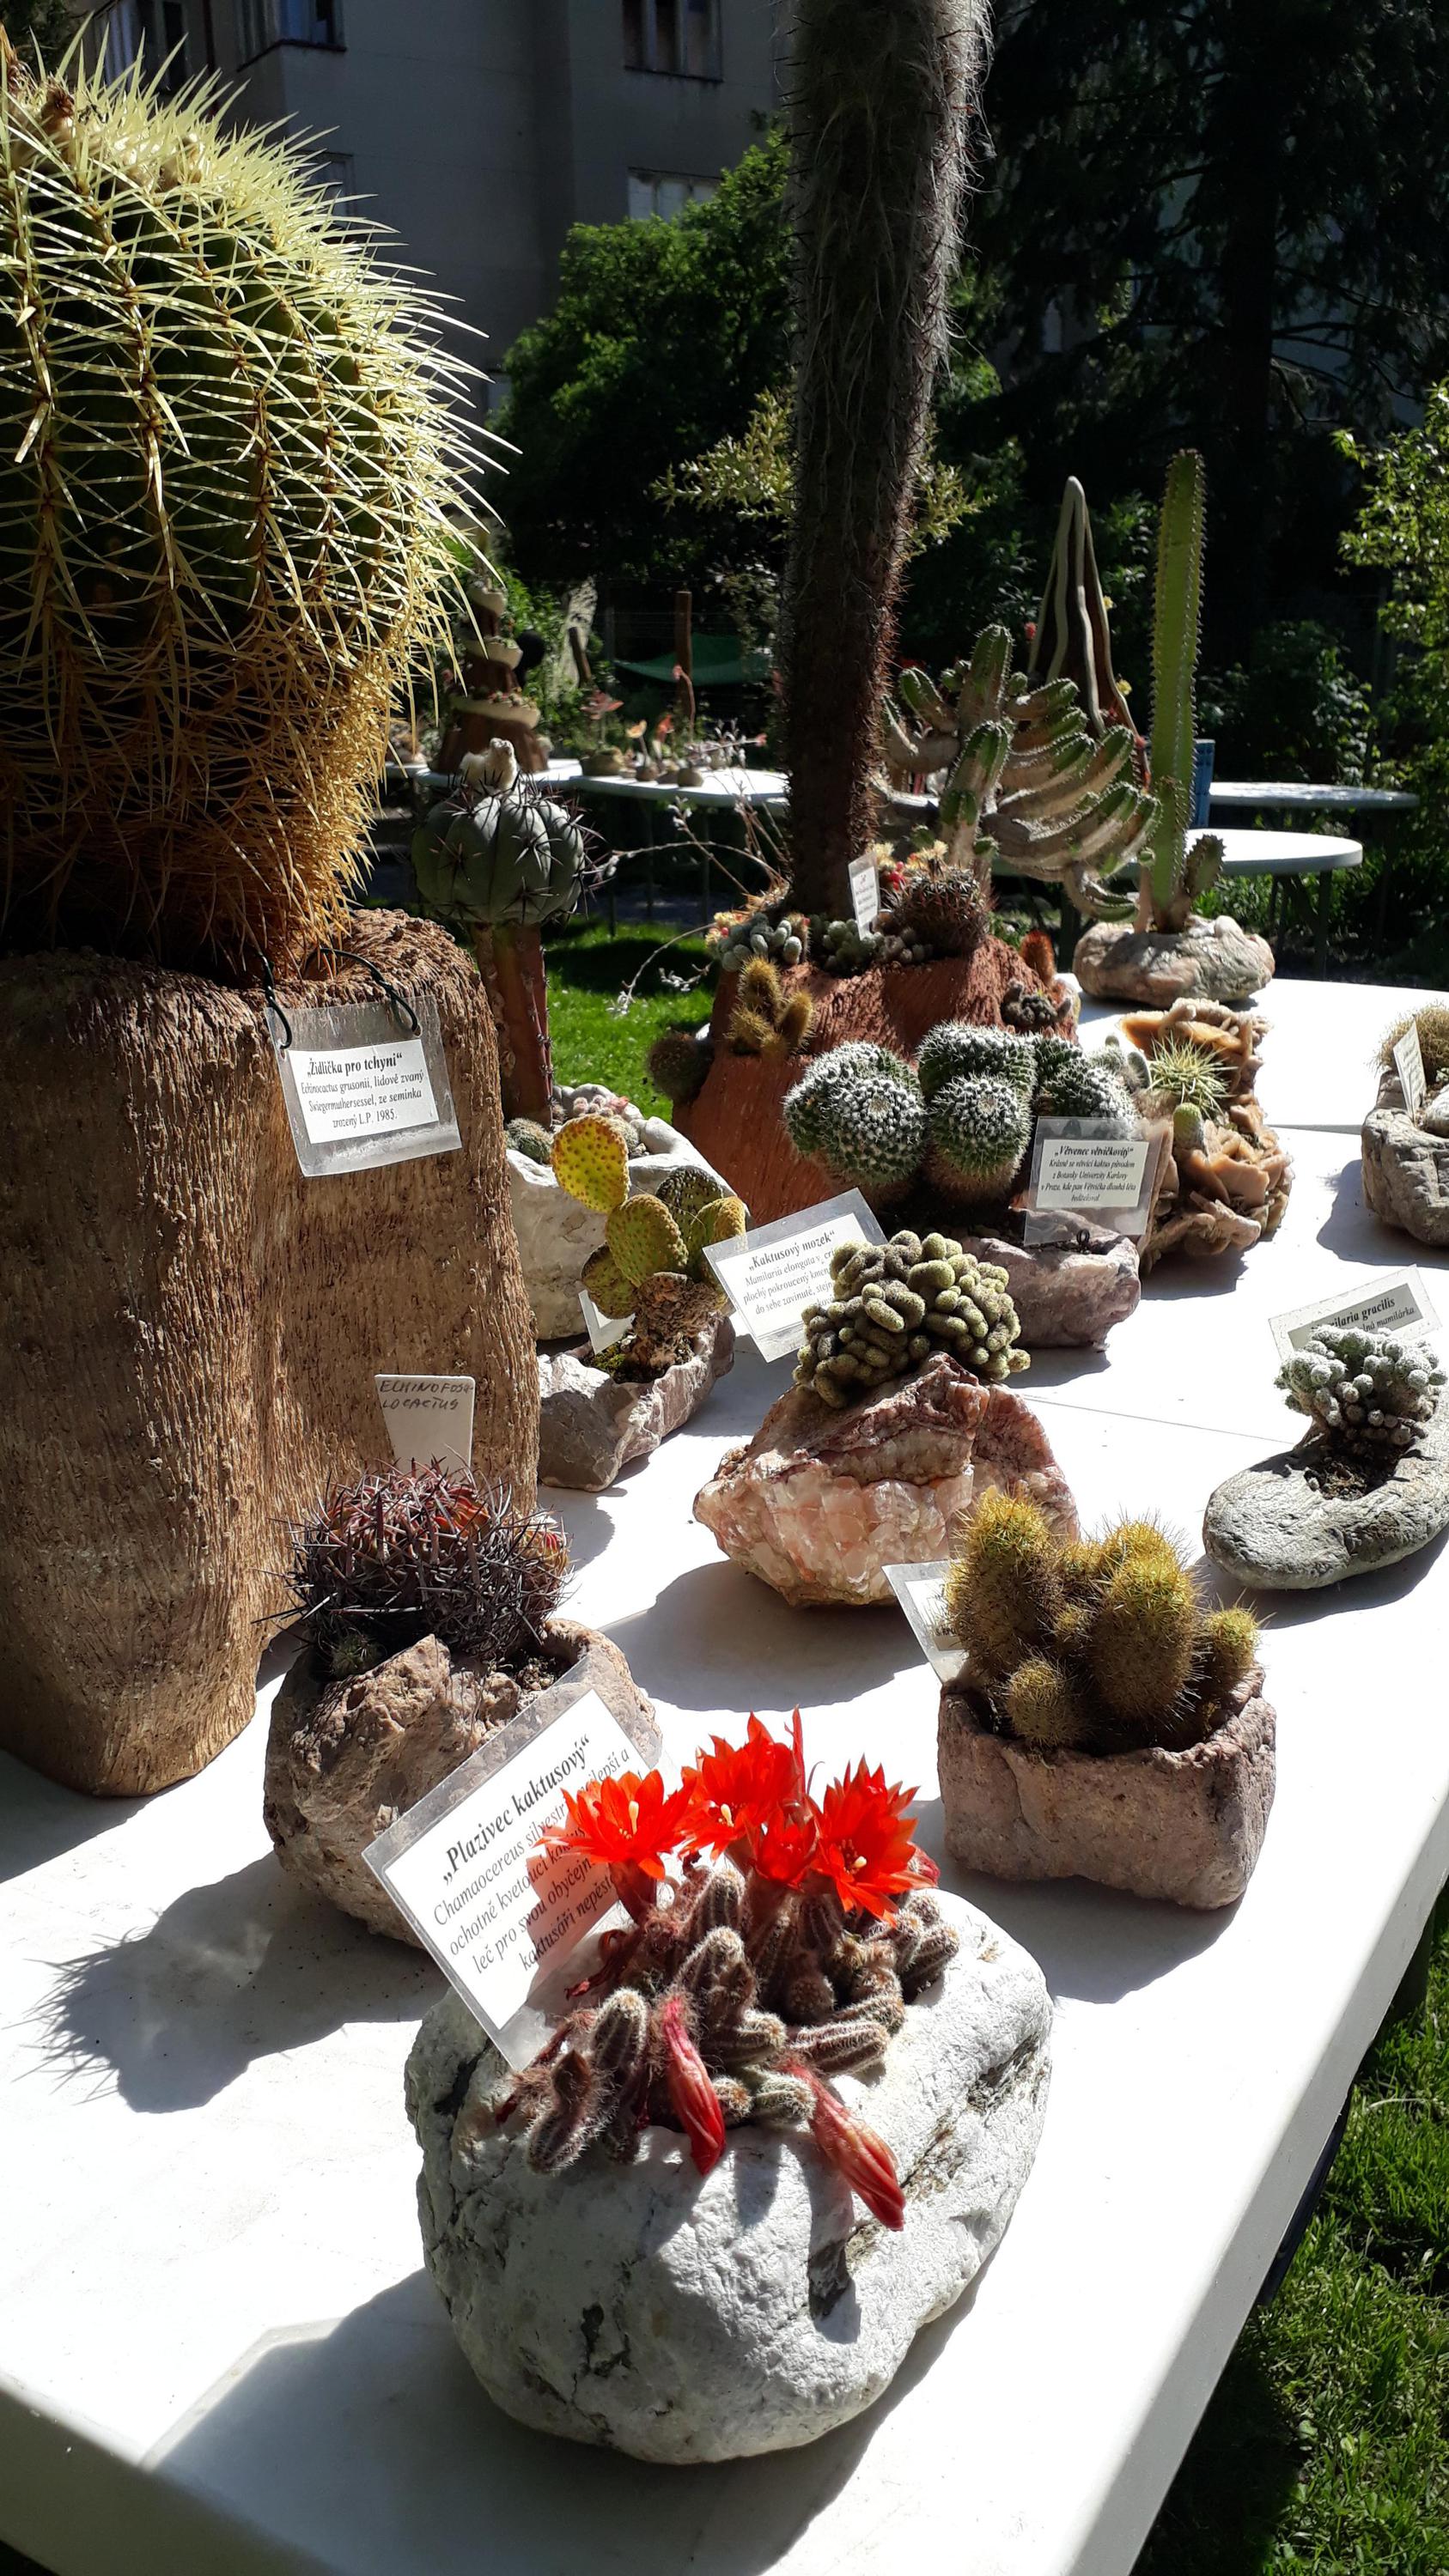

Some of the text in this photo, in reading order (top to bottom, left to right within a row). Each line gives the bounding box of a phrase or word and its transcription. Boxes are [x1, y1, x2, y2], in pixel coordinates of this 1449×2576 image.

[345, 1061, 361, 1076] pro
[364, 1053, 402, 1072] tchyni“
[301, 1069, 424, 1094] Echinocactus grusonii, lidově zvaný
[378, 1094, 387, 1104] ze
[332, 1108, 398, 1128] zrozený L.P. 1985.
[1094, 1159, 1110, 1168] kaktus
[1106, 1171, 1128, 1181] Karlovy
[749, 1230, 835, 1271] „Kaktusový mozek“
[783, 1257, 815, 1273] elongata
[825, 1249, 835, 1260] cri
[744, 1287, 767, 1305] plochý
[768, 1273, 809, 1297] pokroucený
[756, 1304, 764, 1315] do
[767, 1299, 782, 1310] sebe
[816, 1281, 833, 1293] stejn
[1330, 1297, 1396, 1327] ilaria gracilis
[1377, 1307, 1415, 1328] mamilárka
[443, 1733, 589, 1886] „Plazivec kaktusový“
[434, 1841, 525, 1925] Chamaocereus
[526, 1803, 565, 1846] silvestr
[621, 1748, 630, 1763] a
[450, 1899, 498, 1956] ochotně
[472, 1856, 593, 1974] leč pro svou obyčejn
[519, 1908, 577, 1971] kaktusáři
